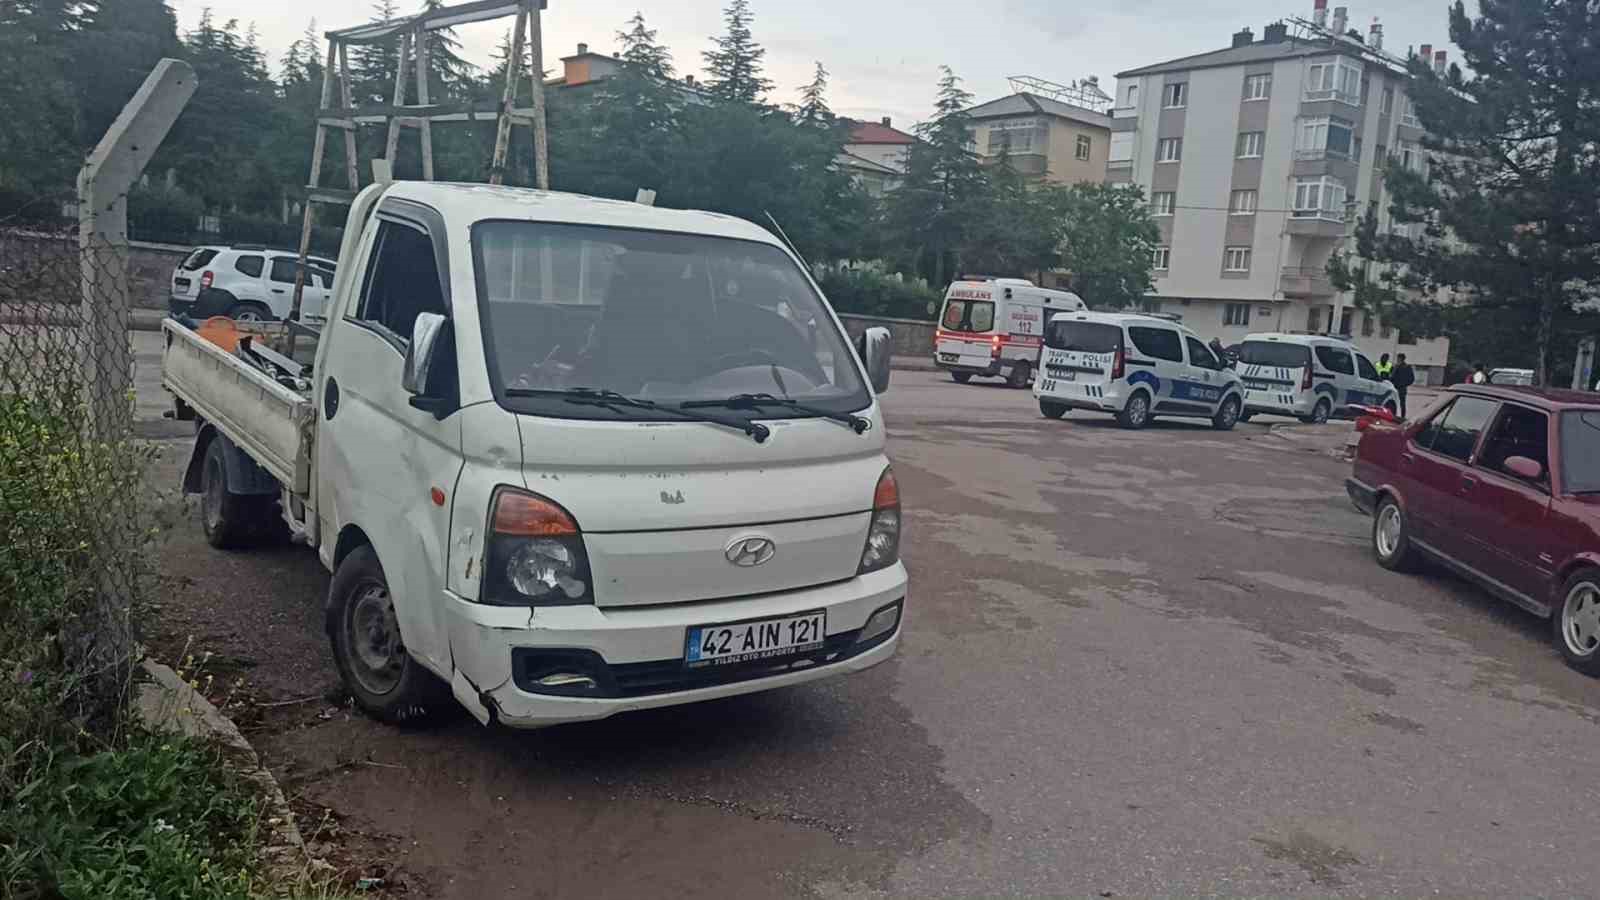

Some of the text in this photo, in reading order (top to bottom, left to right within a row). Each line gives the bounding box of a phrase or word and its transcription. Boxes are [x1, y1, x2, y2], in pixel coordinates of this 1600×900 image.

[951, 288, 992, 300] AMBULANS
[1018, 321, 1032, 334] 112
[702, 618, 819, 655] 42 AIN 121
[743, 652, 759, 661] OTO
[761, 647, 796, 658] KAPORTA
